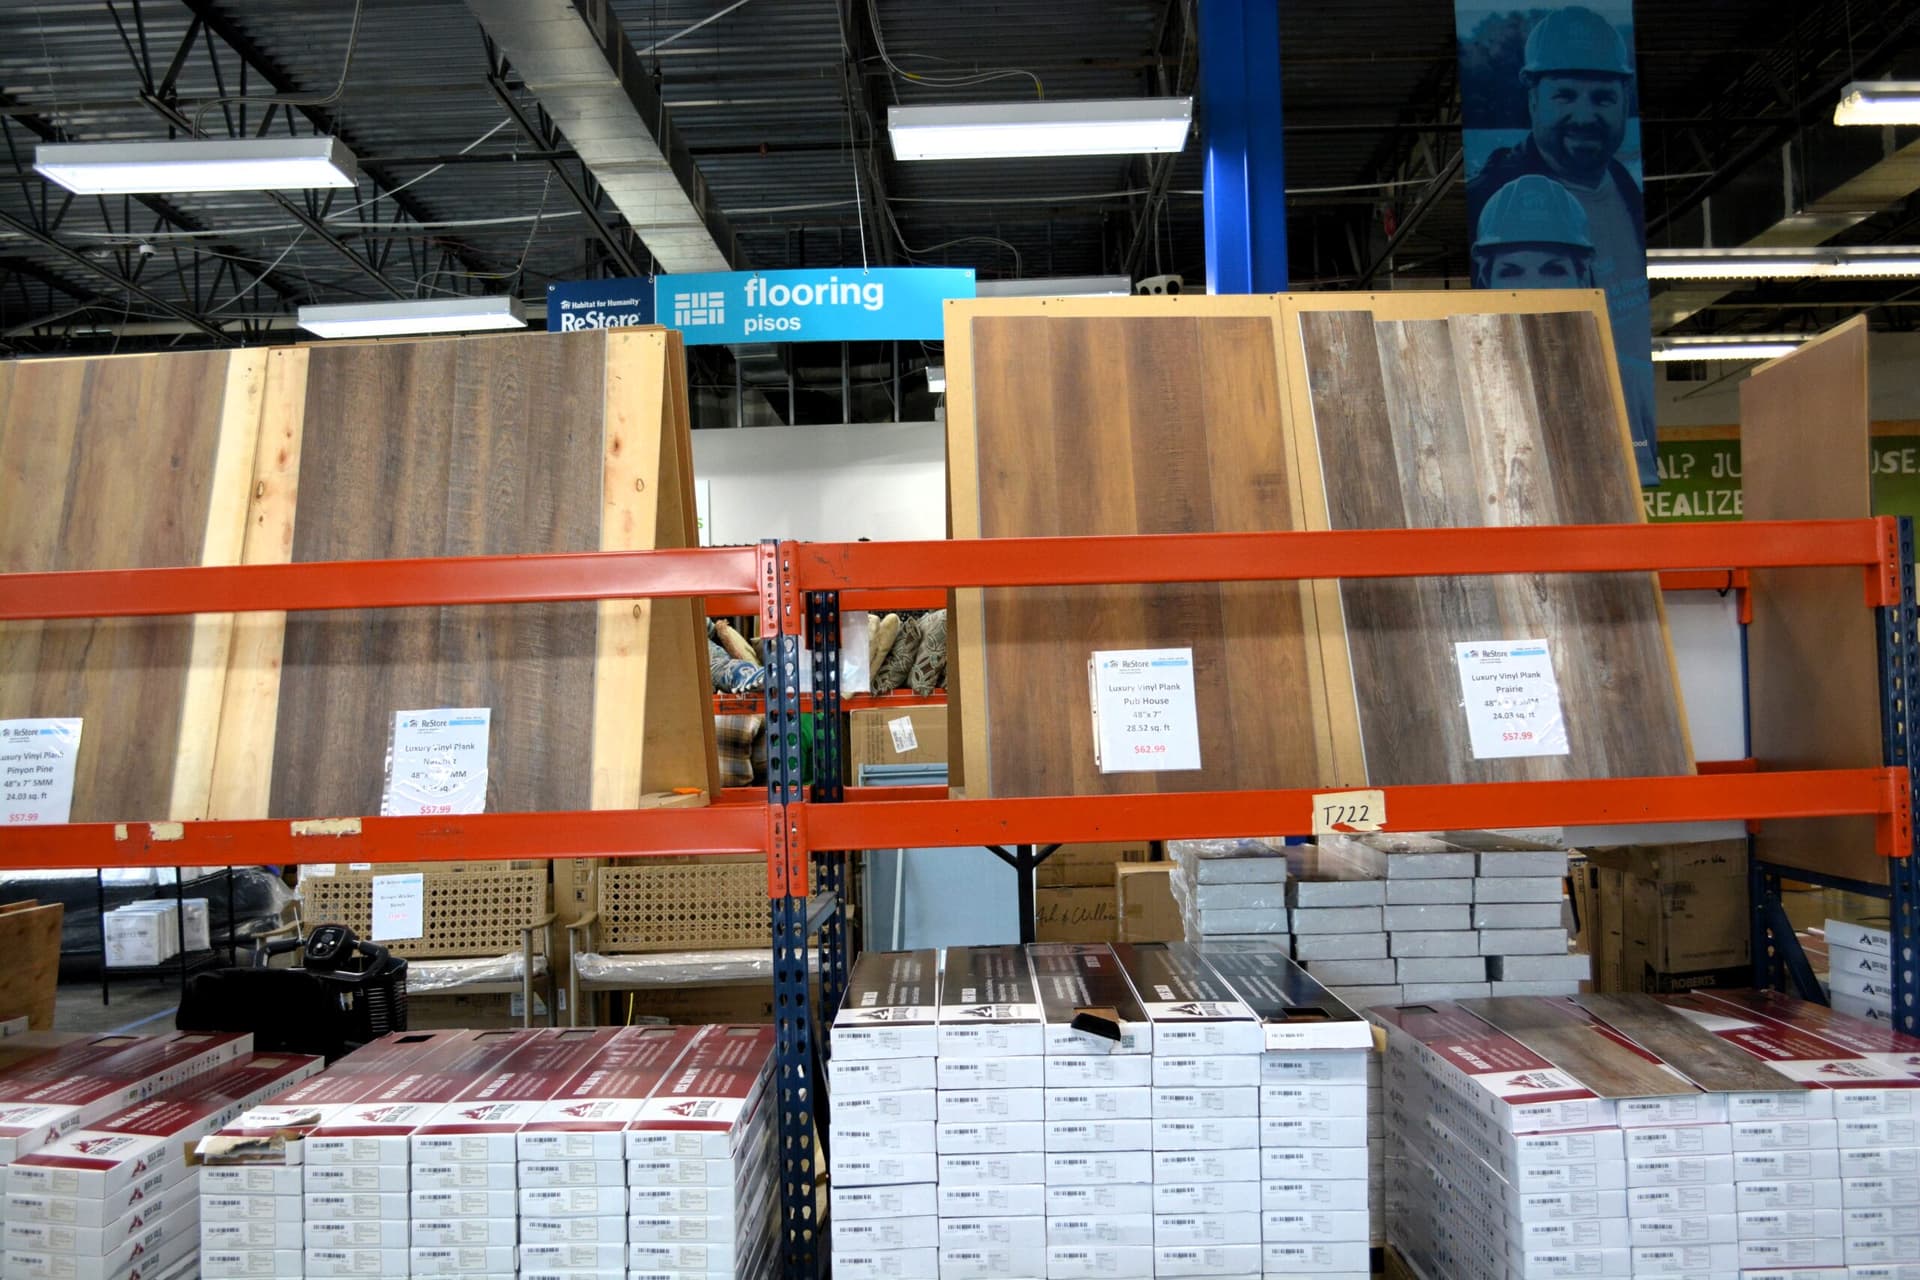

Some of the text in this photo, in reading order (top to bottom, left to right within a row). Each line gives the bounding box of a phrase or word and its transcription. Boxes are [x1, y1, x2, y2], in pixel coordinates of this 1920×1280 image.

[744, 276, 883, 311] flooring
[572, 297, 639, 310] Habitat for Humanity
[561, 310, 640, 331] ReStore
[744, 314, 801, 335] pisos
[1122, 660, 1149, 668] ReStore
[1472, 671, 1541, 682] Luxury Vinyl Plank
[1108, 683, 1181, 693] Luxury Vinyl Plank
[1496, 685, 1523, 693] Prairie
[1142, 697, 1169, 705] House
[421, 719, 448, 728] ReStore
[1126, 724, 1149, 732] 28.52
[1164, 724, 1170, 732] ft
[1503, 732, 1533, 742] $57.99
[405, 745, 432, 753] Luxury
[1134, 745, 1166, 754] $62.99
[0, 754, 21, 762] uxury
[23, 752, 42, 761] Vinyl
[7, 764, 54, 775] Pinyon Pine
[6, 793, 27, 801] 24.03
[420, 804, 452, 814] $57.99
[9, 812, 39, 822] $57.99
[1323, 805, 1369, 826] T222
